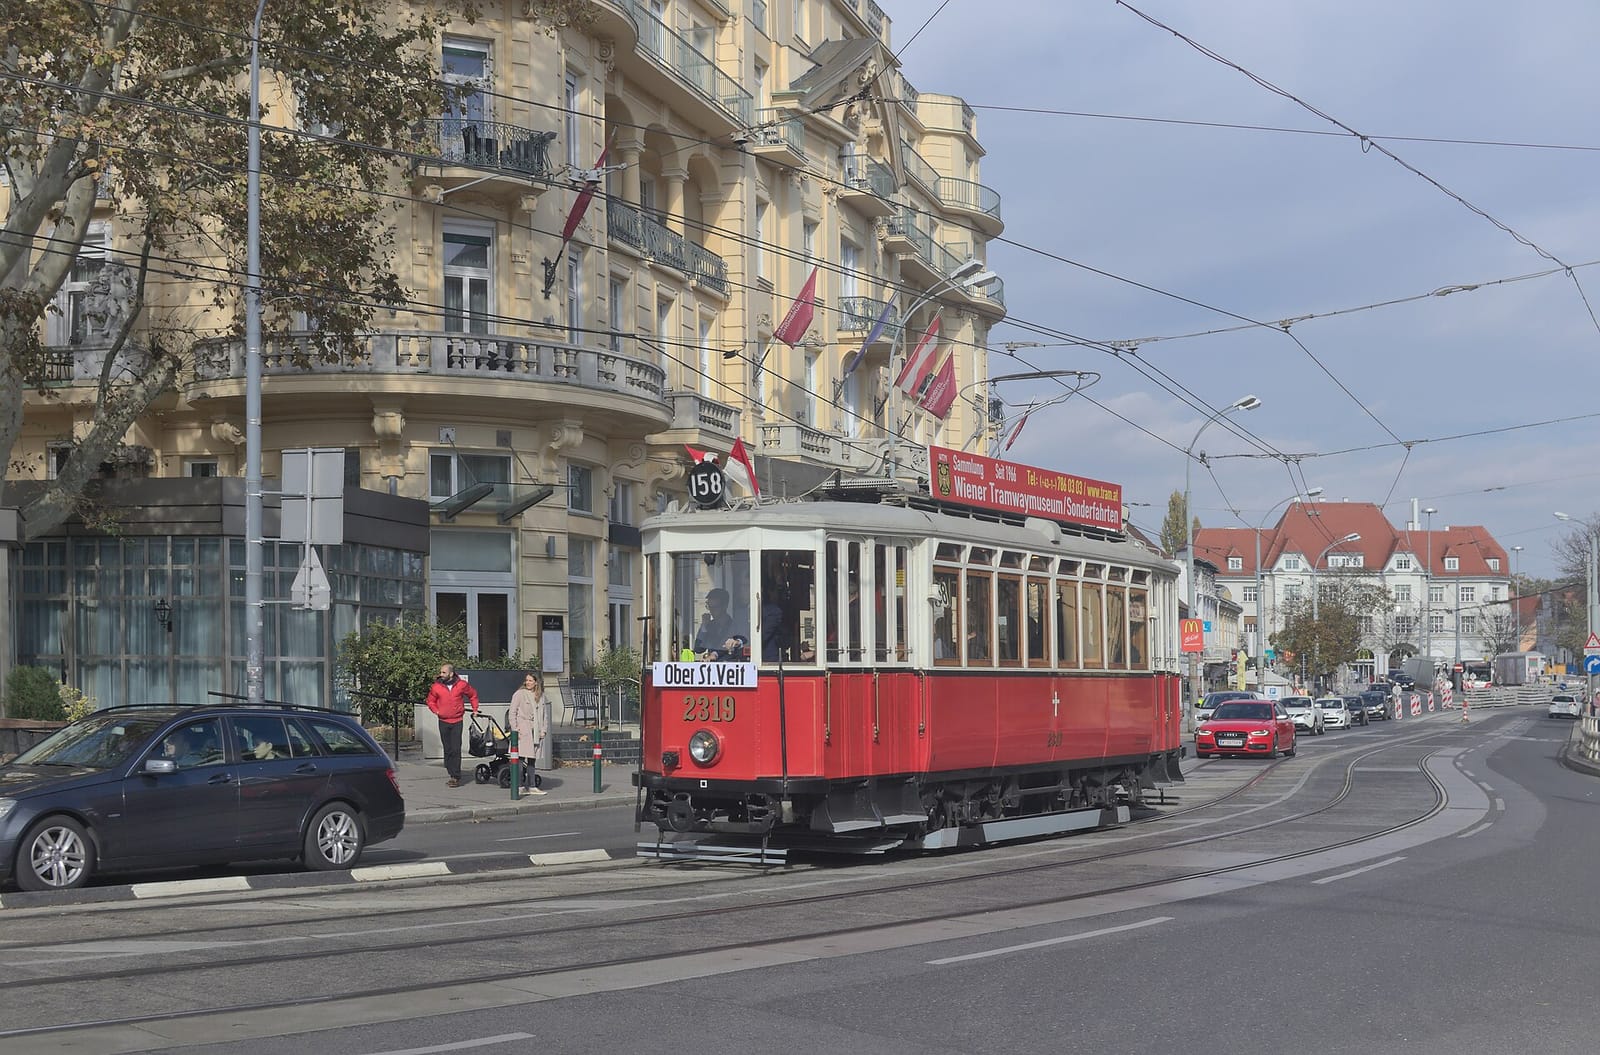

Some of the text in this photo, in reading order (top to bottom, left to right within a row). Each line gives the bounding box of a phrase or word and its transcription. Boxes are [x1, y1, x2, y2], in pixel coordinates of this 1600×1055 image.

[689, 471, 722, 497] 158
[952, 454, 984, 479] Sammlung
[995, 463, 1005, 480] Seit
[1005, 465, 1017, 482] 1966
[1026, 469, 1038, 487] Tel:
[1057, 476, 1067, 492] 786
[1067, 478, 1075, 494] 03
[1075, 480, 1083, 496] 03
[953, 475, 987, 502] Wiener
[664, 663, 695, 685] Ober
[682, 695, 736, 723] 2319
